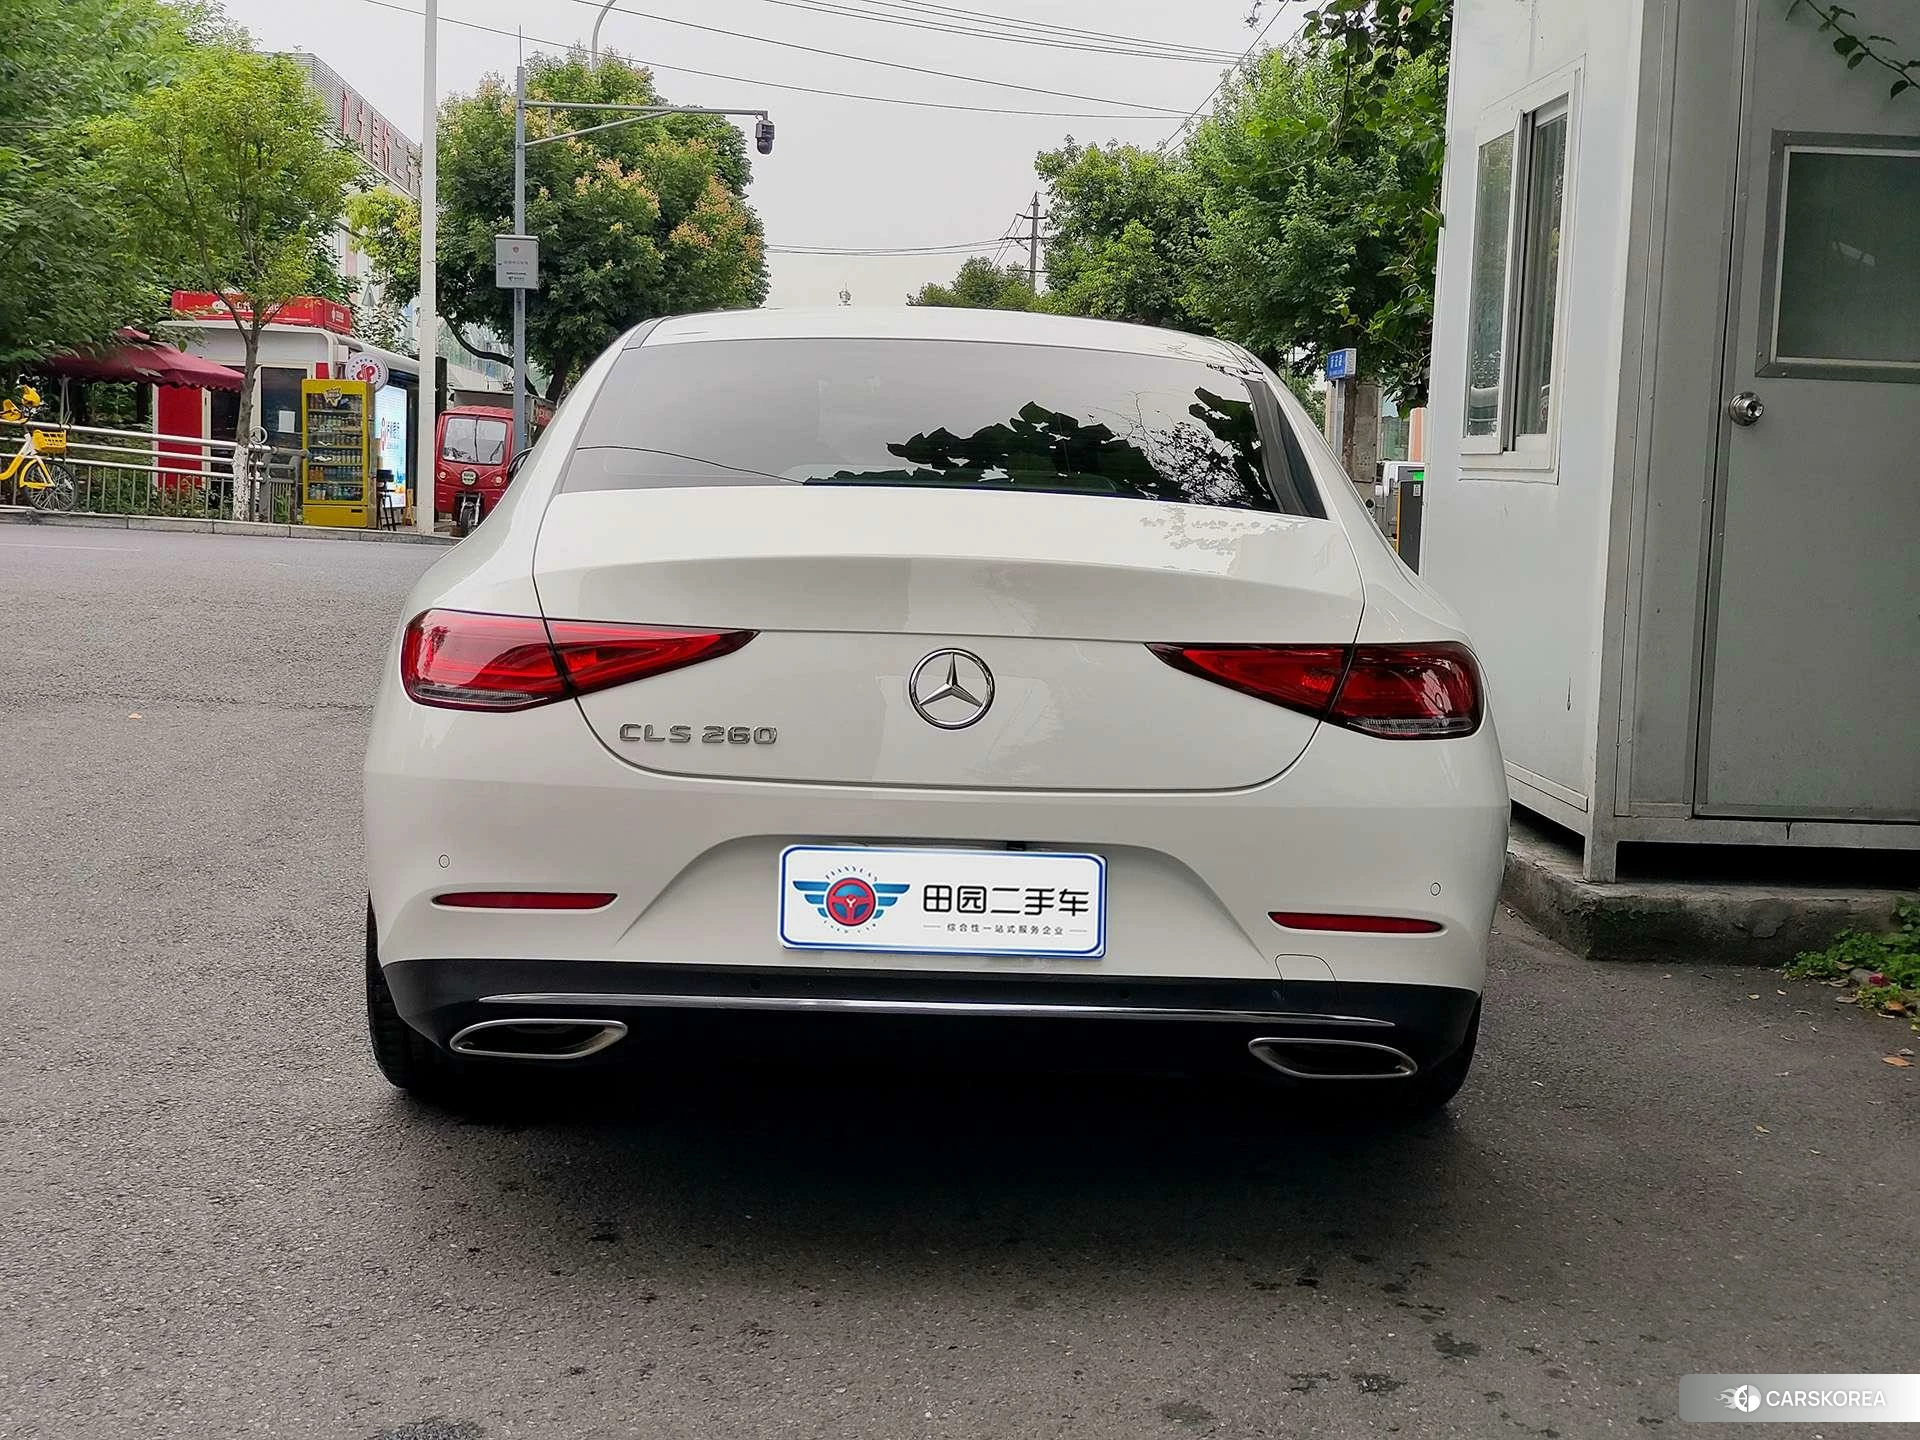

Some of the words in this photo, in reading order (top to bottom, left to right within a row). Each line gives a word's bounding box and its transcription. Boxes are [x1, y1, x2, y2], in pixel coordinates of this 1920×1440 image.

[619, 723, 692, 743] CLS
[701, 725, 778, 745] 260
[923, 884, 1090, 917] 田园二手车
[946, 923, 1064, 936] 综合性一站式服务企业
